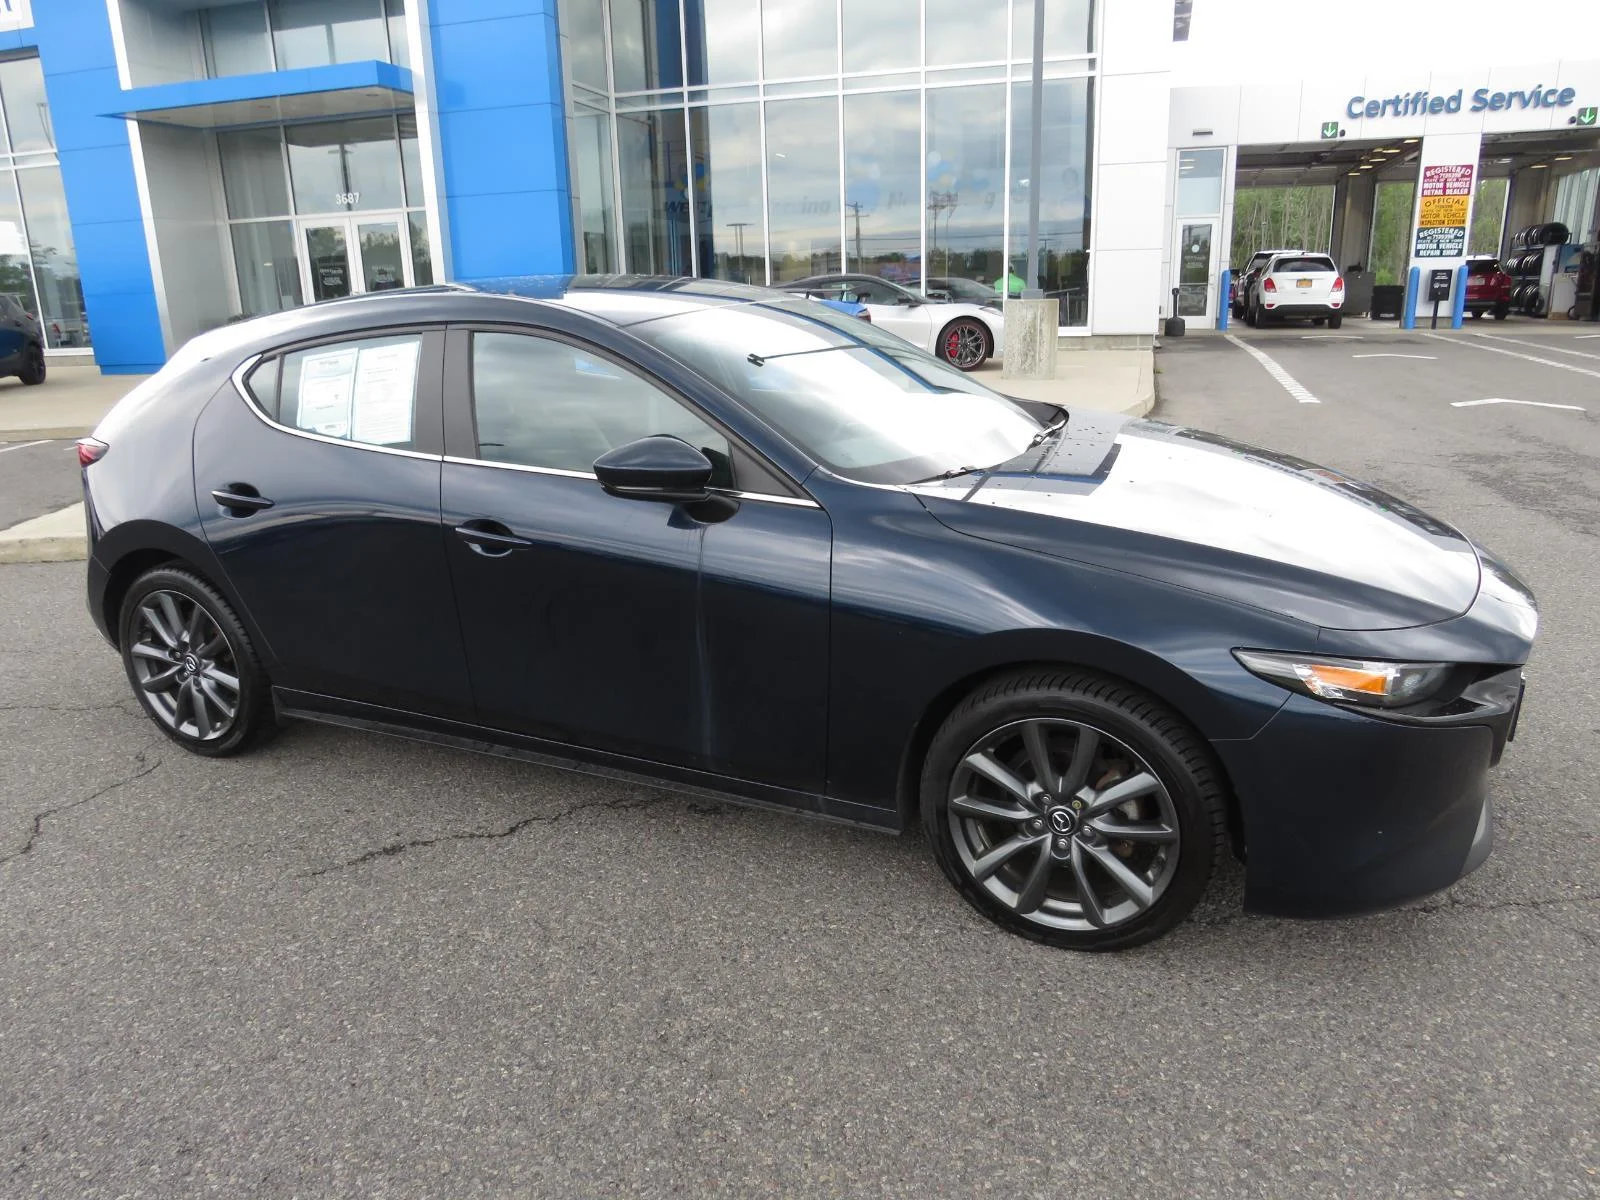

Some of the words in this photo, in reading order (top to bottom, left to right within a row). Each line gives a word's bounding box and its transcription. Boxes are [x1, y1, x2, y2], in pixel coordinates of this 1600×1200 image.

[1347, 89, 1463, 119] Certified
[1470, 84, 1577, 112] Service
[1426, 166, 1471, 177] REGISTERED
[335, 192, 360, 205] 3687
[1424, 197, 1465, 207] OFFICIAL
[1419, 228, 1464, 238] REGISTERED
